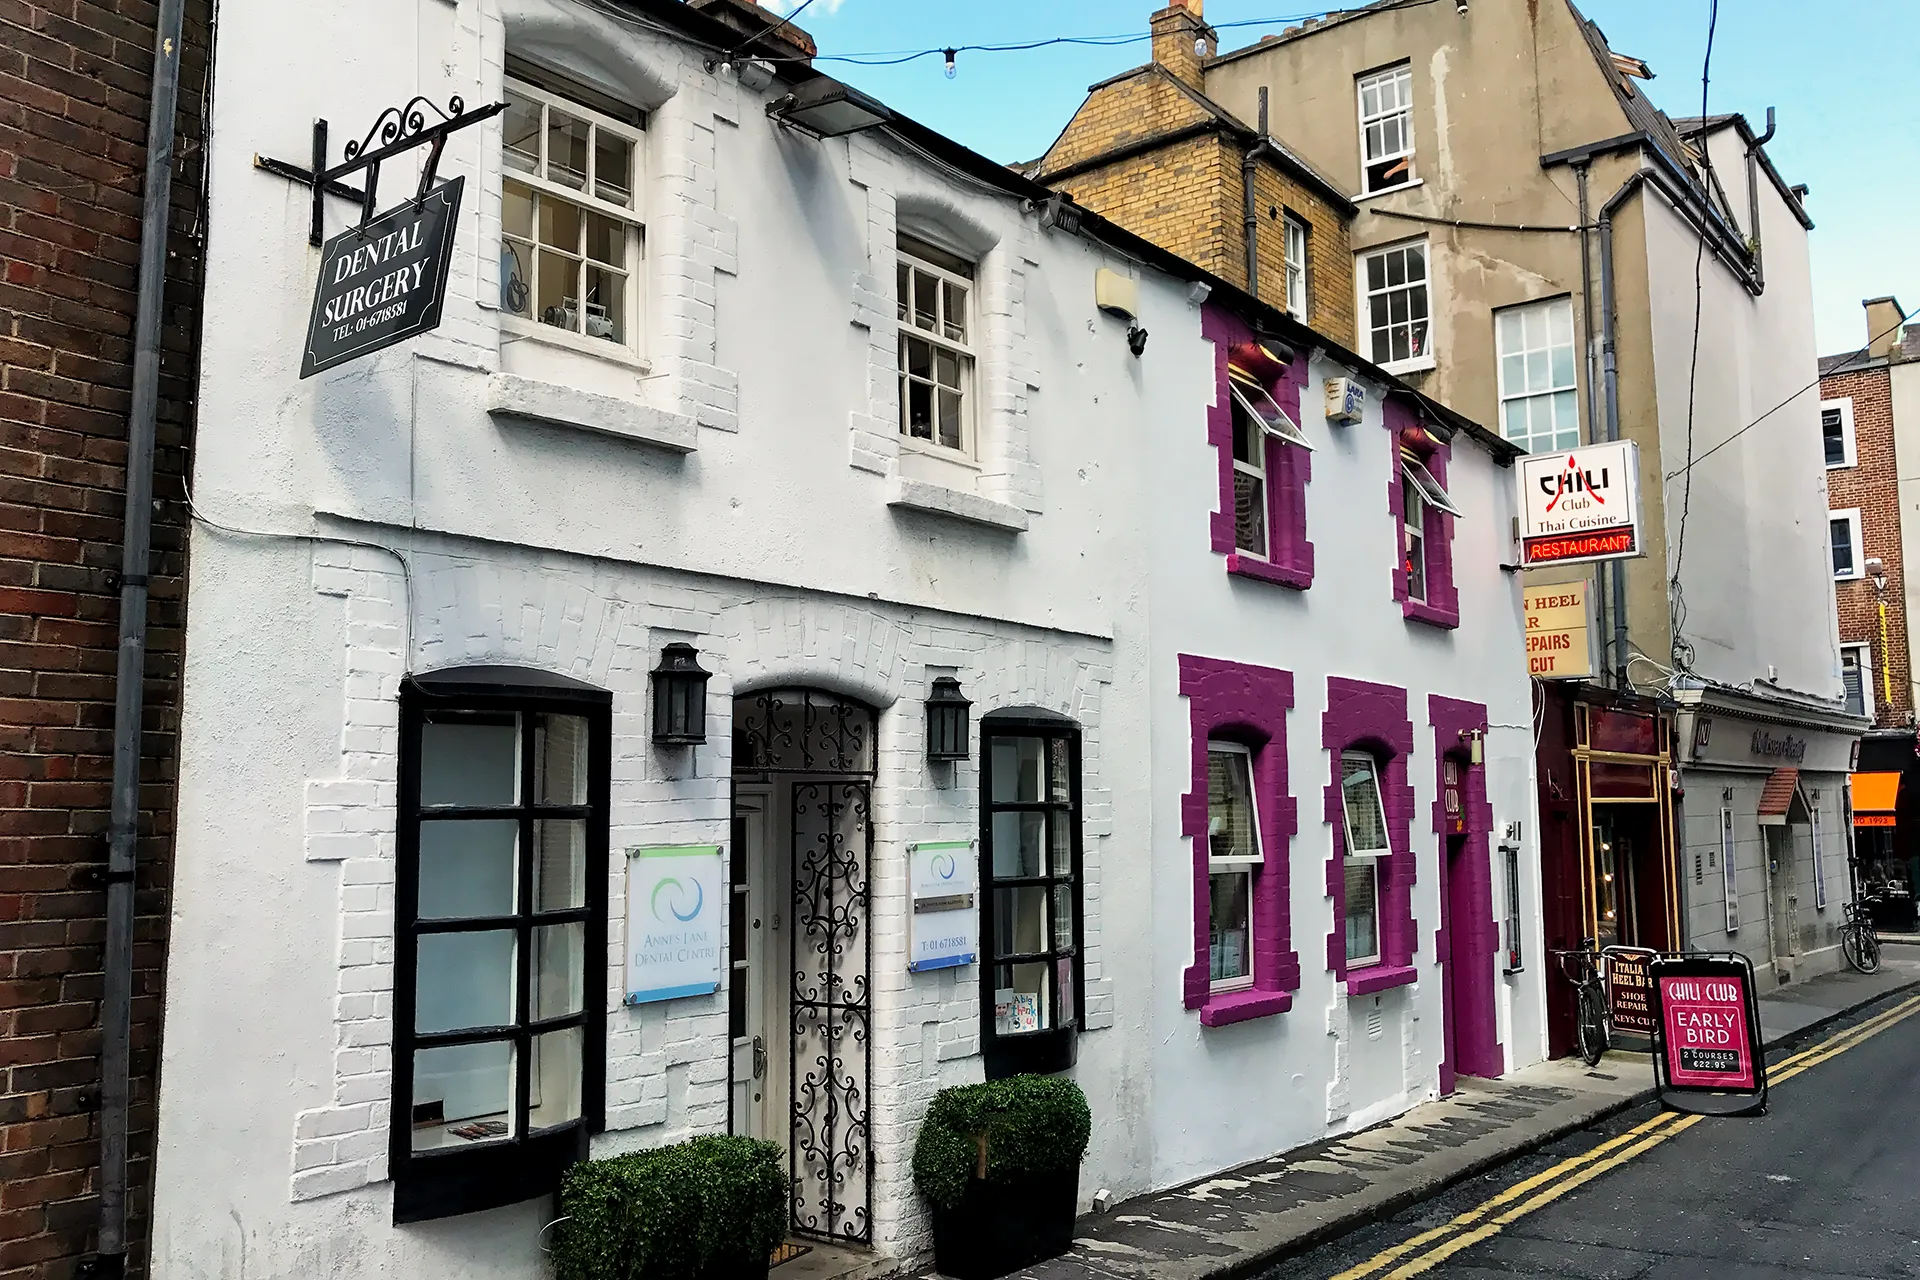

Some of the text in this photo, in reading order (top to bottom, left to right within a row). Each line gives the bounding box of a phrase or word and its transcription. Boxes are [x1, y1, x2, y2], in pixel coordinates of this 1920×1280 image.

[332, 219, 424, 285] DENTAL
[321, 256, 431, 328] SURGERY
[332, 299, 408, 342] TEL: 01-6718581
[1540, 467, 1609, 496] CHILI
[1561, 497, 1591, 512] Club
[1538, 513, 1617, 533] Thai Cuisine
[1531, 535, 1631, 558] RESTAURANT
[1535, 594, 1581, 610] HEEL
[1530, 656, 1556, 673] CUT
[940, 936, 967, 949] 6718581
[635, 948, 715, 966] DENTAL CENTRE
[1615, 961, 1649, 975] ITALIA
[1612, 973, 1635, 986] HEEL
[1621, 991, 1646, 1002] SHOE
[1669, 983, 1738, 1002] CHILI CLUB
[1616, 1000, 1648, 1012] REPAIR
[1614, 1014, 1636, 1024] KEYS
[1677, 1012, 1735, 1028] EARLY
[1687, 1028, 1730, 1044] BIRD
[1683, 1051, 1734, 1061] 2 COURSES
[1693, 1060, 1726, 1069] €22.95
